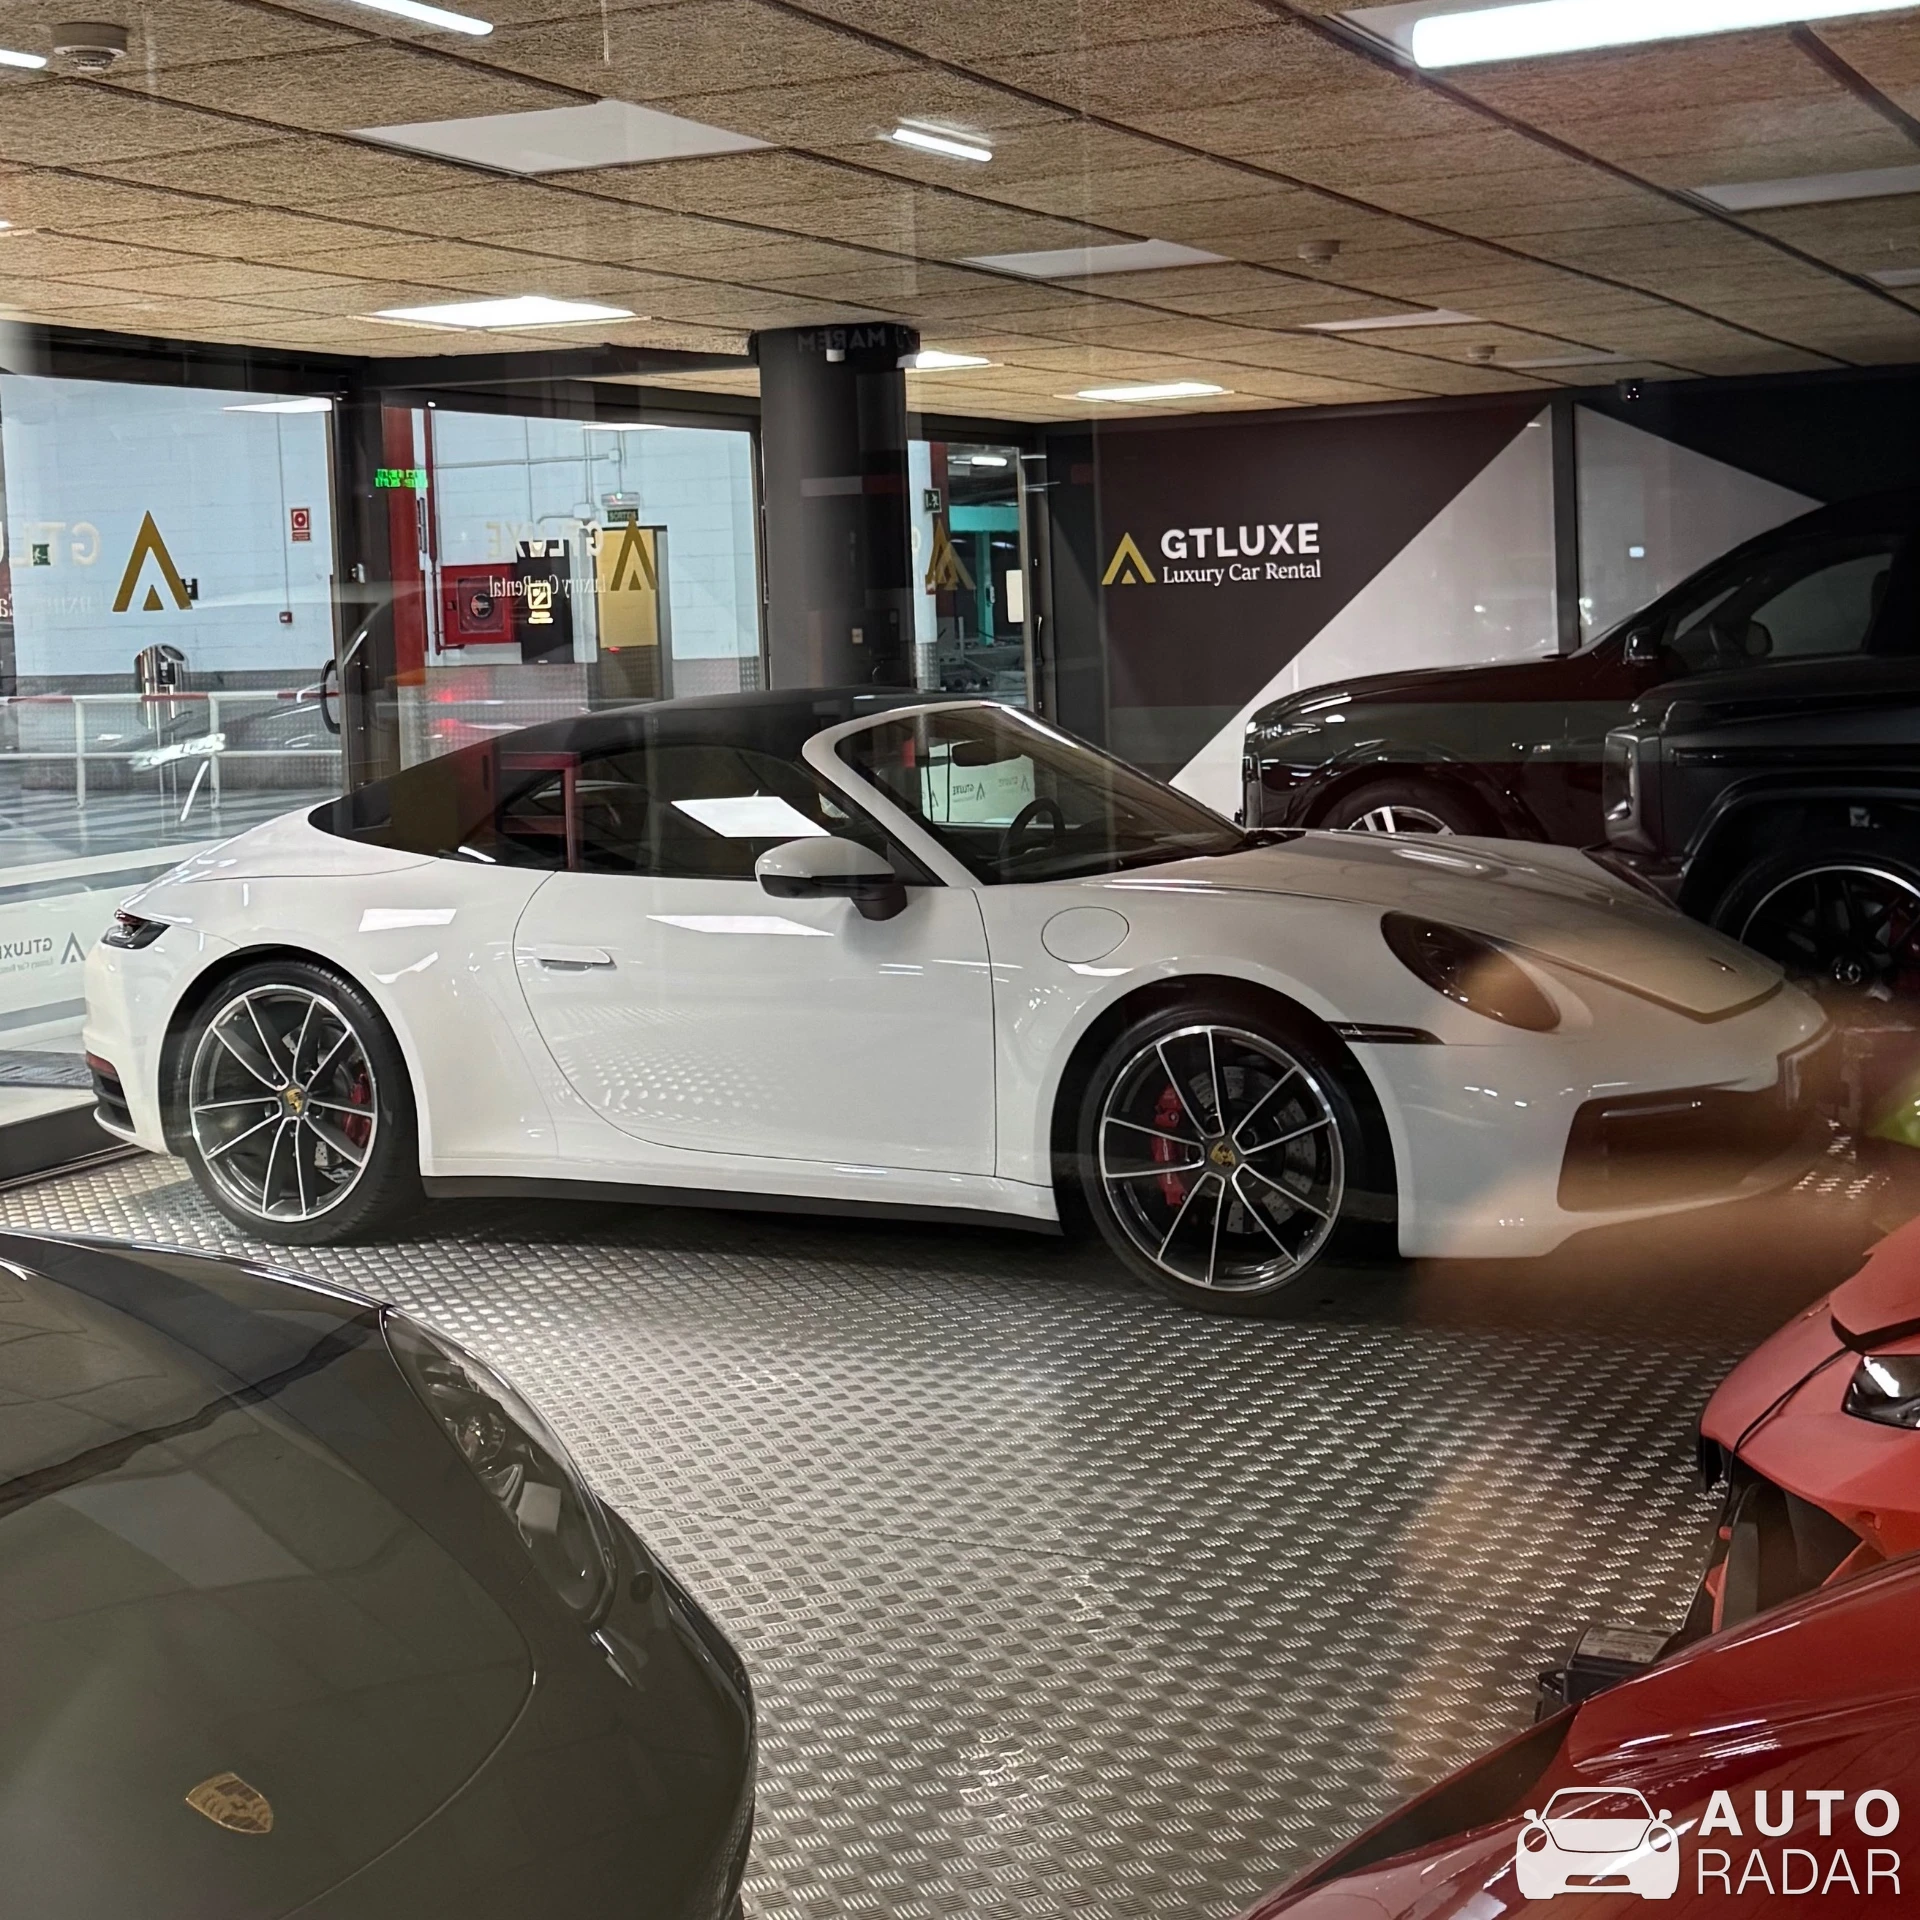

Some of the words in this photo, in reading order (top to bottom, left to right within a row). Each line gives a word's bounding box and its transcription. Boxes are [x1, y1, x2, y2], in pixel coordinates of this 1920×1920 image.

[1160, 522, 1320, 560] GTLUXE
[1163, 566, 1225, 587] Luxury
[1229, 563, 1260, 581] Car
[1266, 559, 1322, 580] Rental
